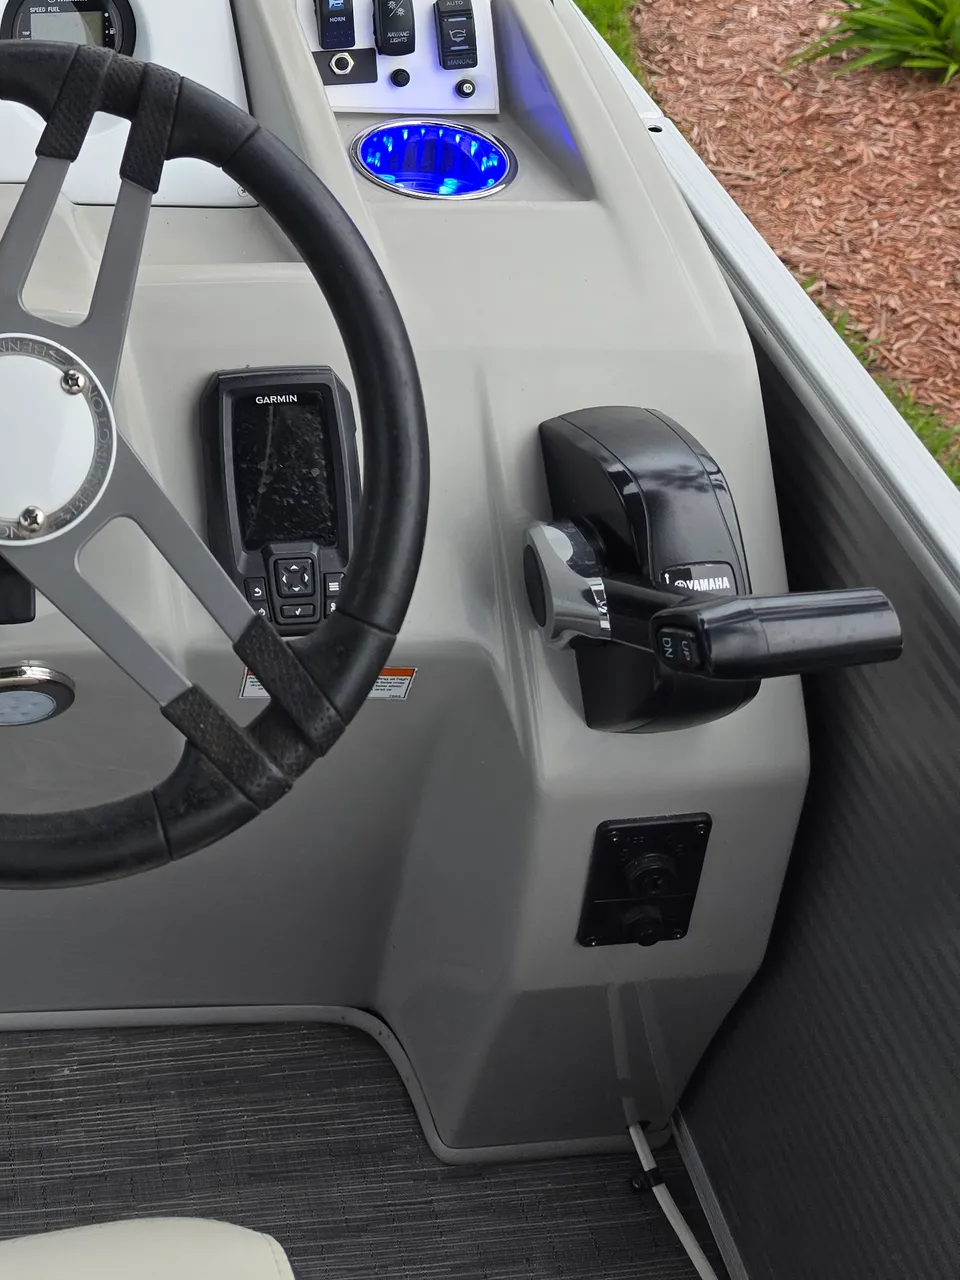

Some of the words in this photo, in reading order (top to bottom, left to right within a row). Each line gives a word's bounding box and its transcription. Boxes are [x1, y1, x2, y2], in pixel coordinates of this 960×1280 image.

[447, 58, 474, 66] MANUAL
[255, 394, 298, 404] GARMIN
[686, 576, 731, 592] YAMAHA
[662, 637, 674, 658] DN
[681, 640, 691, 661] UP
